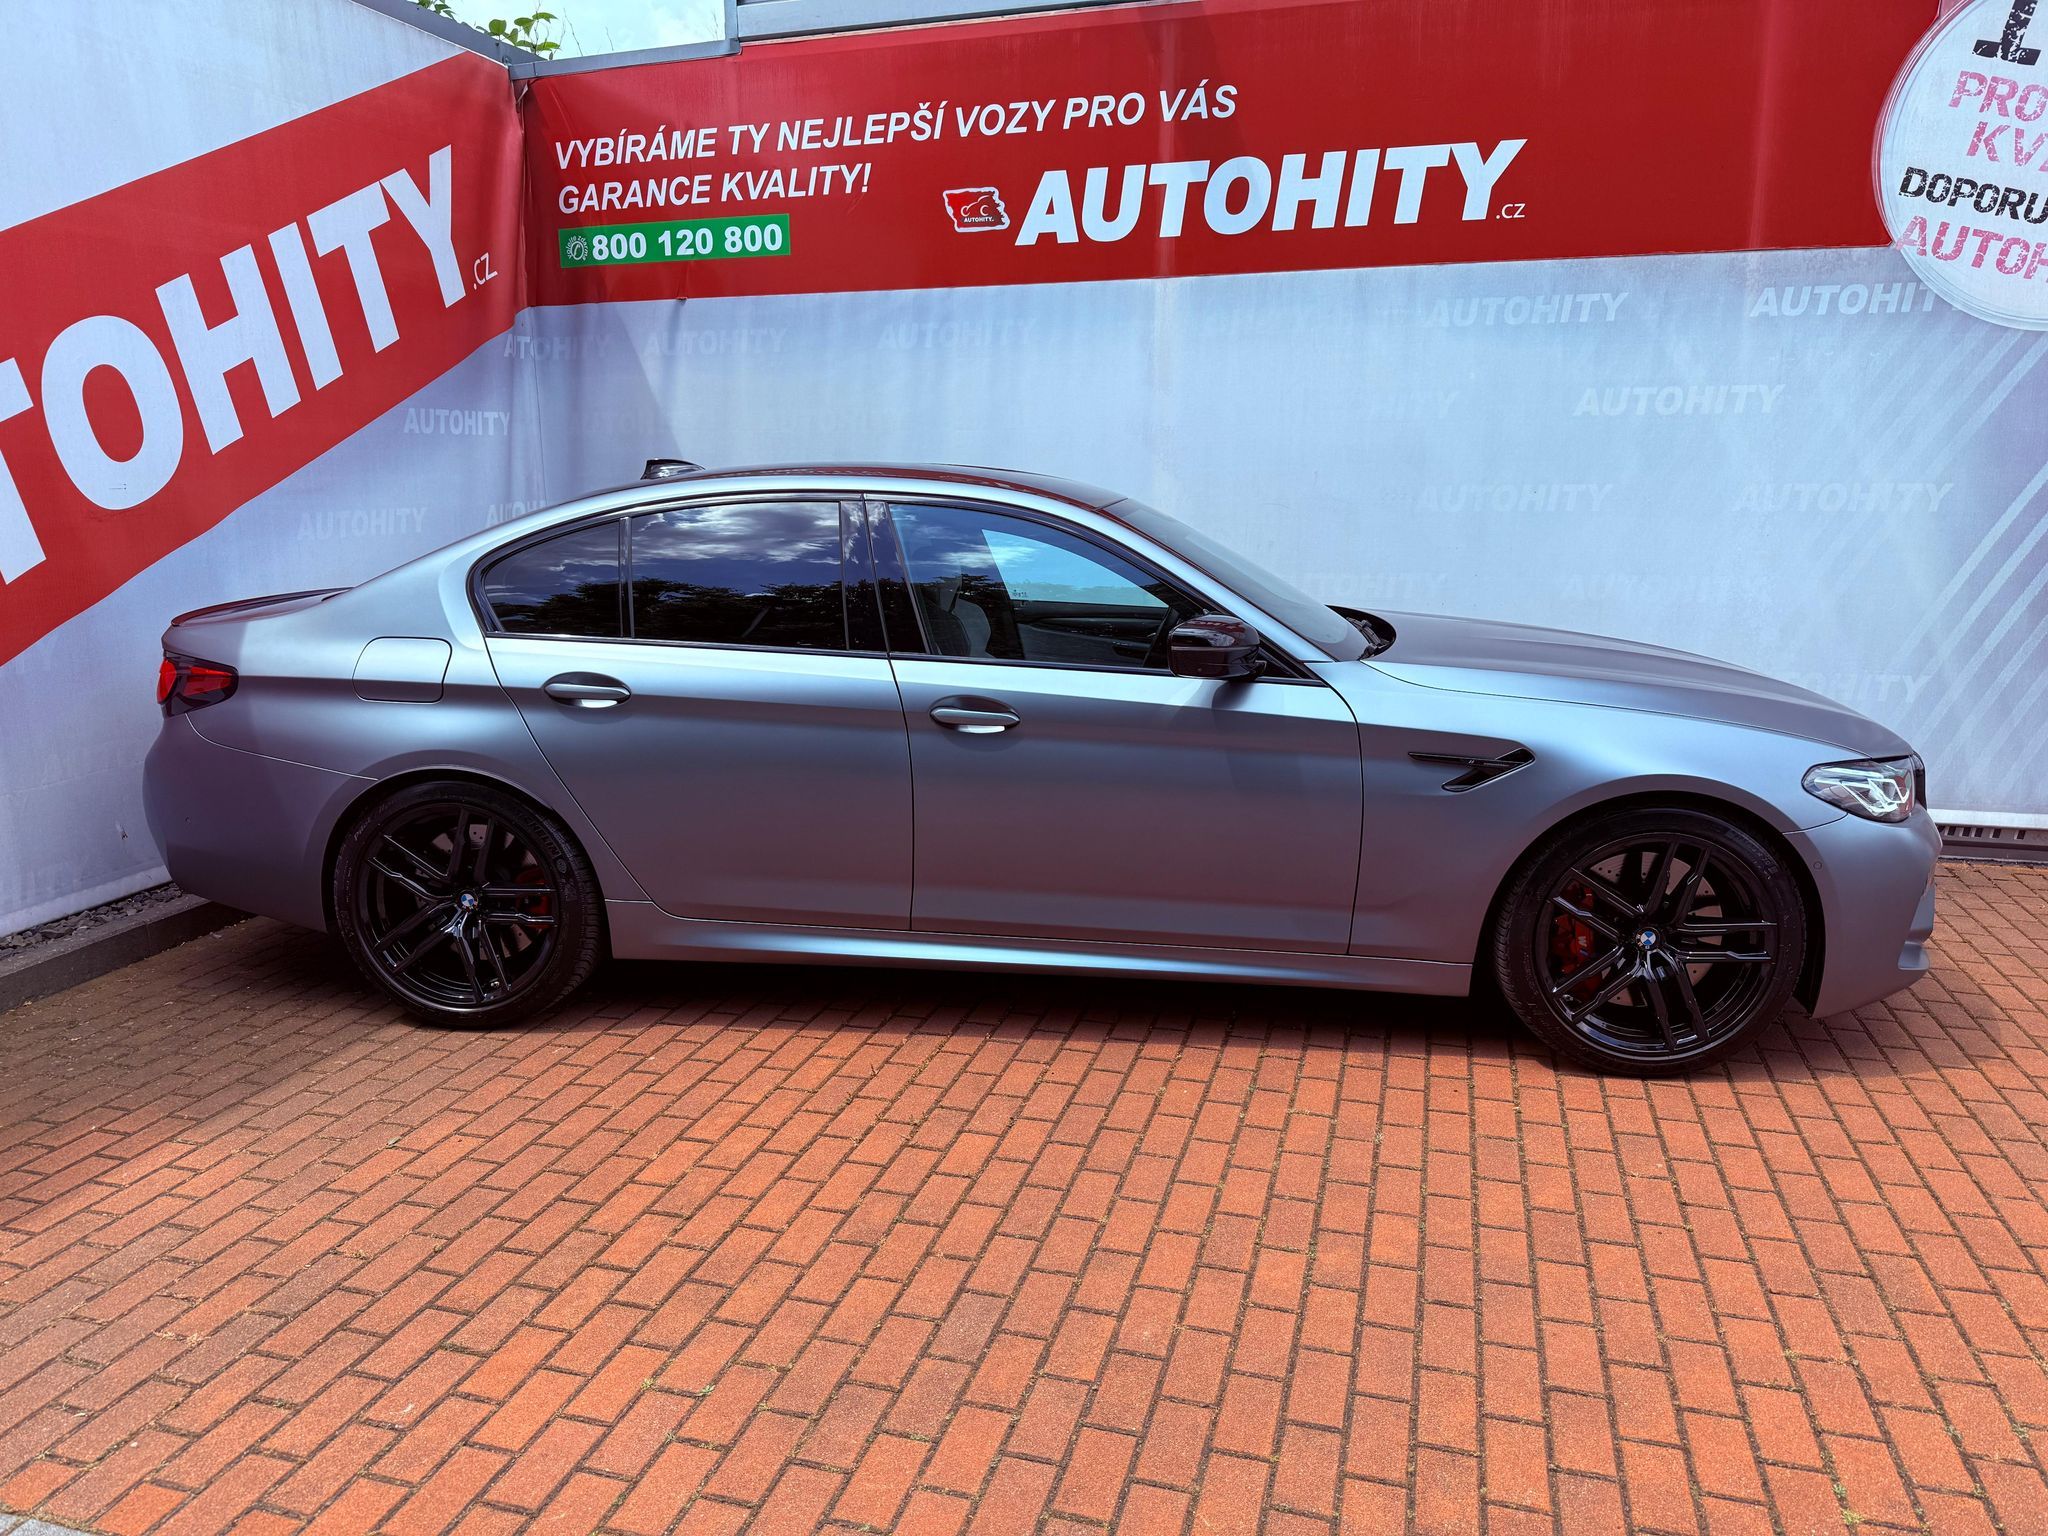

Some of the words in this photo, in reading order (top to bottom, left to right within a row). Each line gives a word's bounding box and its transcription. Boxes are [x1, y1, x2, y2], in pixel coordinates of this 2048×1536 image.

[556, 125, 717, 169] VYBÍRÁME
[728, 123, 770, 154] TY
[777, 101, 947, 151] NEJLEPŠÍ
[956, 100, 1056, 137] VOZY
[1063, 93, 1145, 129] PRO
[1160, 79, 1237, 121] VÁS
[559, 175, 712, 214] GARANCE
[721, 163, 872, 201] KVALITY!
[1015, 139, 1527, 245] AUTOHITY
[593, 232, 646, 260] 800
[658, 228, 713, 256] 120
[725, 224, 782, 253] 800
[1430, 292, 1630, 328] AUTOHITY
[1573, 384, 1786, 417] AUTOHITY
[404, 408, 511, 436] AUTOHITY
[1413, 483, 1615, 513] AUTOHITY
[1731, 482, 1955, 513] AUTOHITY
[297, 507, 427, 541] AUTOHITY
